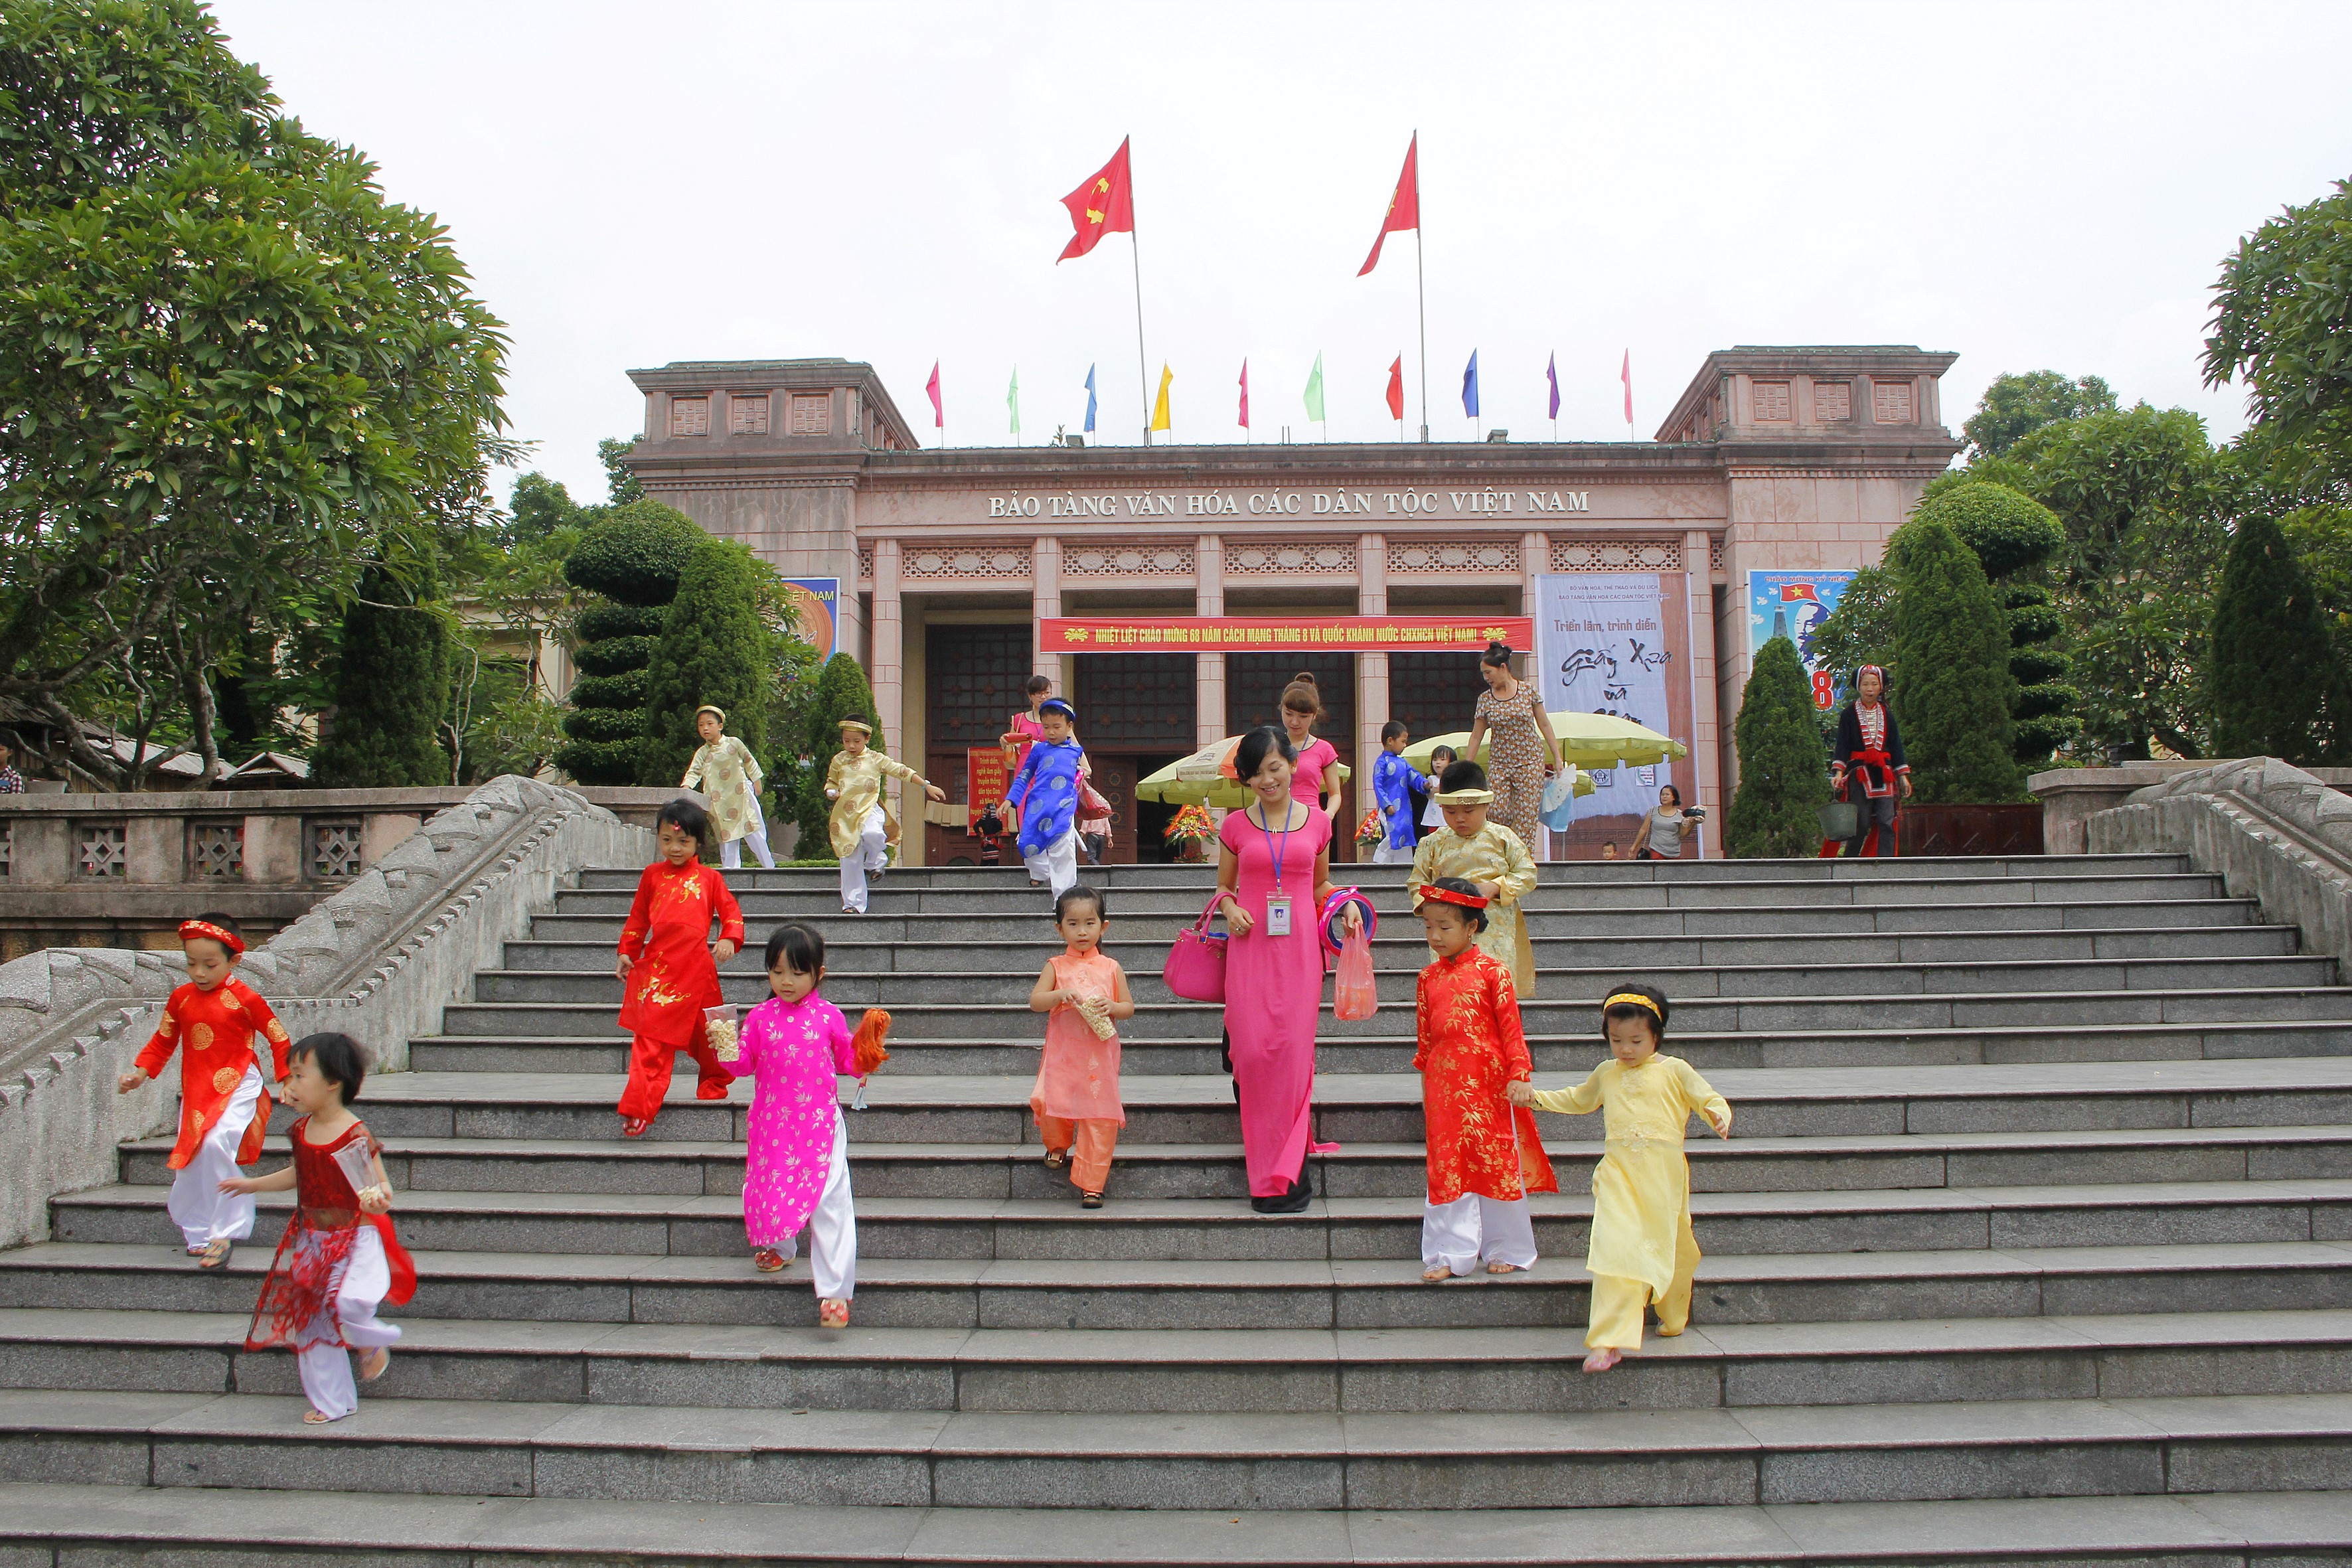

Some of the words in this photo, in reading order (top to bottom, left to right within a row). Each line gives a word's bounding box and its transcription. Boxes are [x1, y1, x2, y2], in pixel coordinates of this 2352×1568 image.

[988, 490, 1040, 517] BẢO
[1048, 490, 1118, 516] TÀNG
[1124, 489, 1176, 516] VĂN
[1186, 489, 1239, 515] HÓA
[1248, 487, 1301, 514] CÁC
[1312, 487, 1373, 514] DÂN
[1383, 487, 1439, 518] TỘC
[1449, 486, 1516, 517] VIỆT
[1527, 491, 1589, 512] NAM
[809, 590, 835, 601] NAM
[1095, 625, 1119, 646] NHIỆT
[1121, 625, 1137, 646] LIỆT
[1139, 625, 1162, 643] CHÀO
[1163, 625, 1188, 643] MỪNG
[1190, 628, 1200, 643] 68
[1202, 625, 1221, 643] NĂM
[1223, 625, 1245, 643] CÁCH
[1247, 627, 1271, 645] MẠNG
[1273, 625, 1300, 643] THÁNG
[1302, 627, 1308, 642] 8
[1310, 625, 1320, 642] VÀ
[1322, 623, 1344, 644] QUỐC
[1346, 624, 1374, 642] KHÁNH
[1376, 623, 1399, 642] NƯỚC
[1401, 627, 1435, 642] CHXHCN
[1435, 625, 1454, 645] VIỆT
[1454, 627, 1478, 642] NAM!
[1554, 619, 1581, 633] Triển
[1607, 617, 1633, 631] trình
[1635, 617, 1657, 631] diễn
